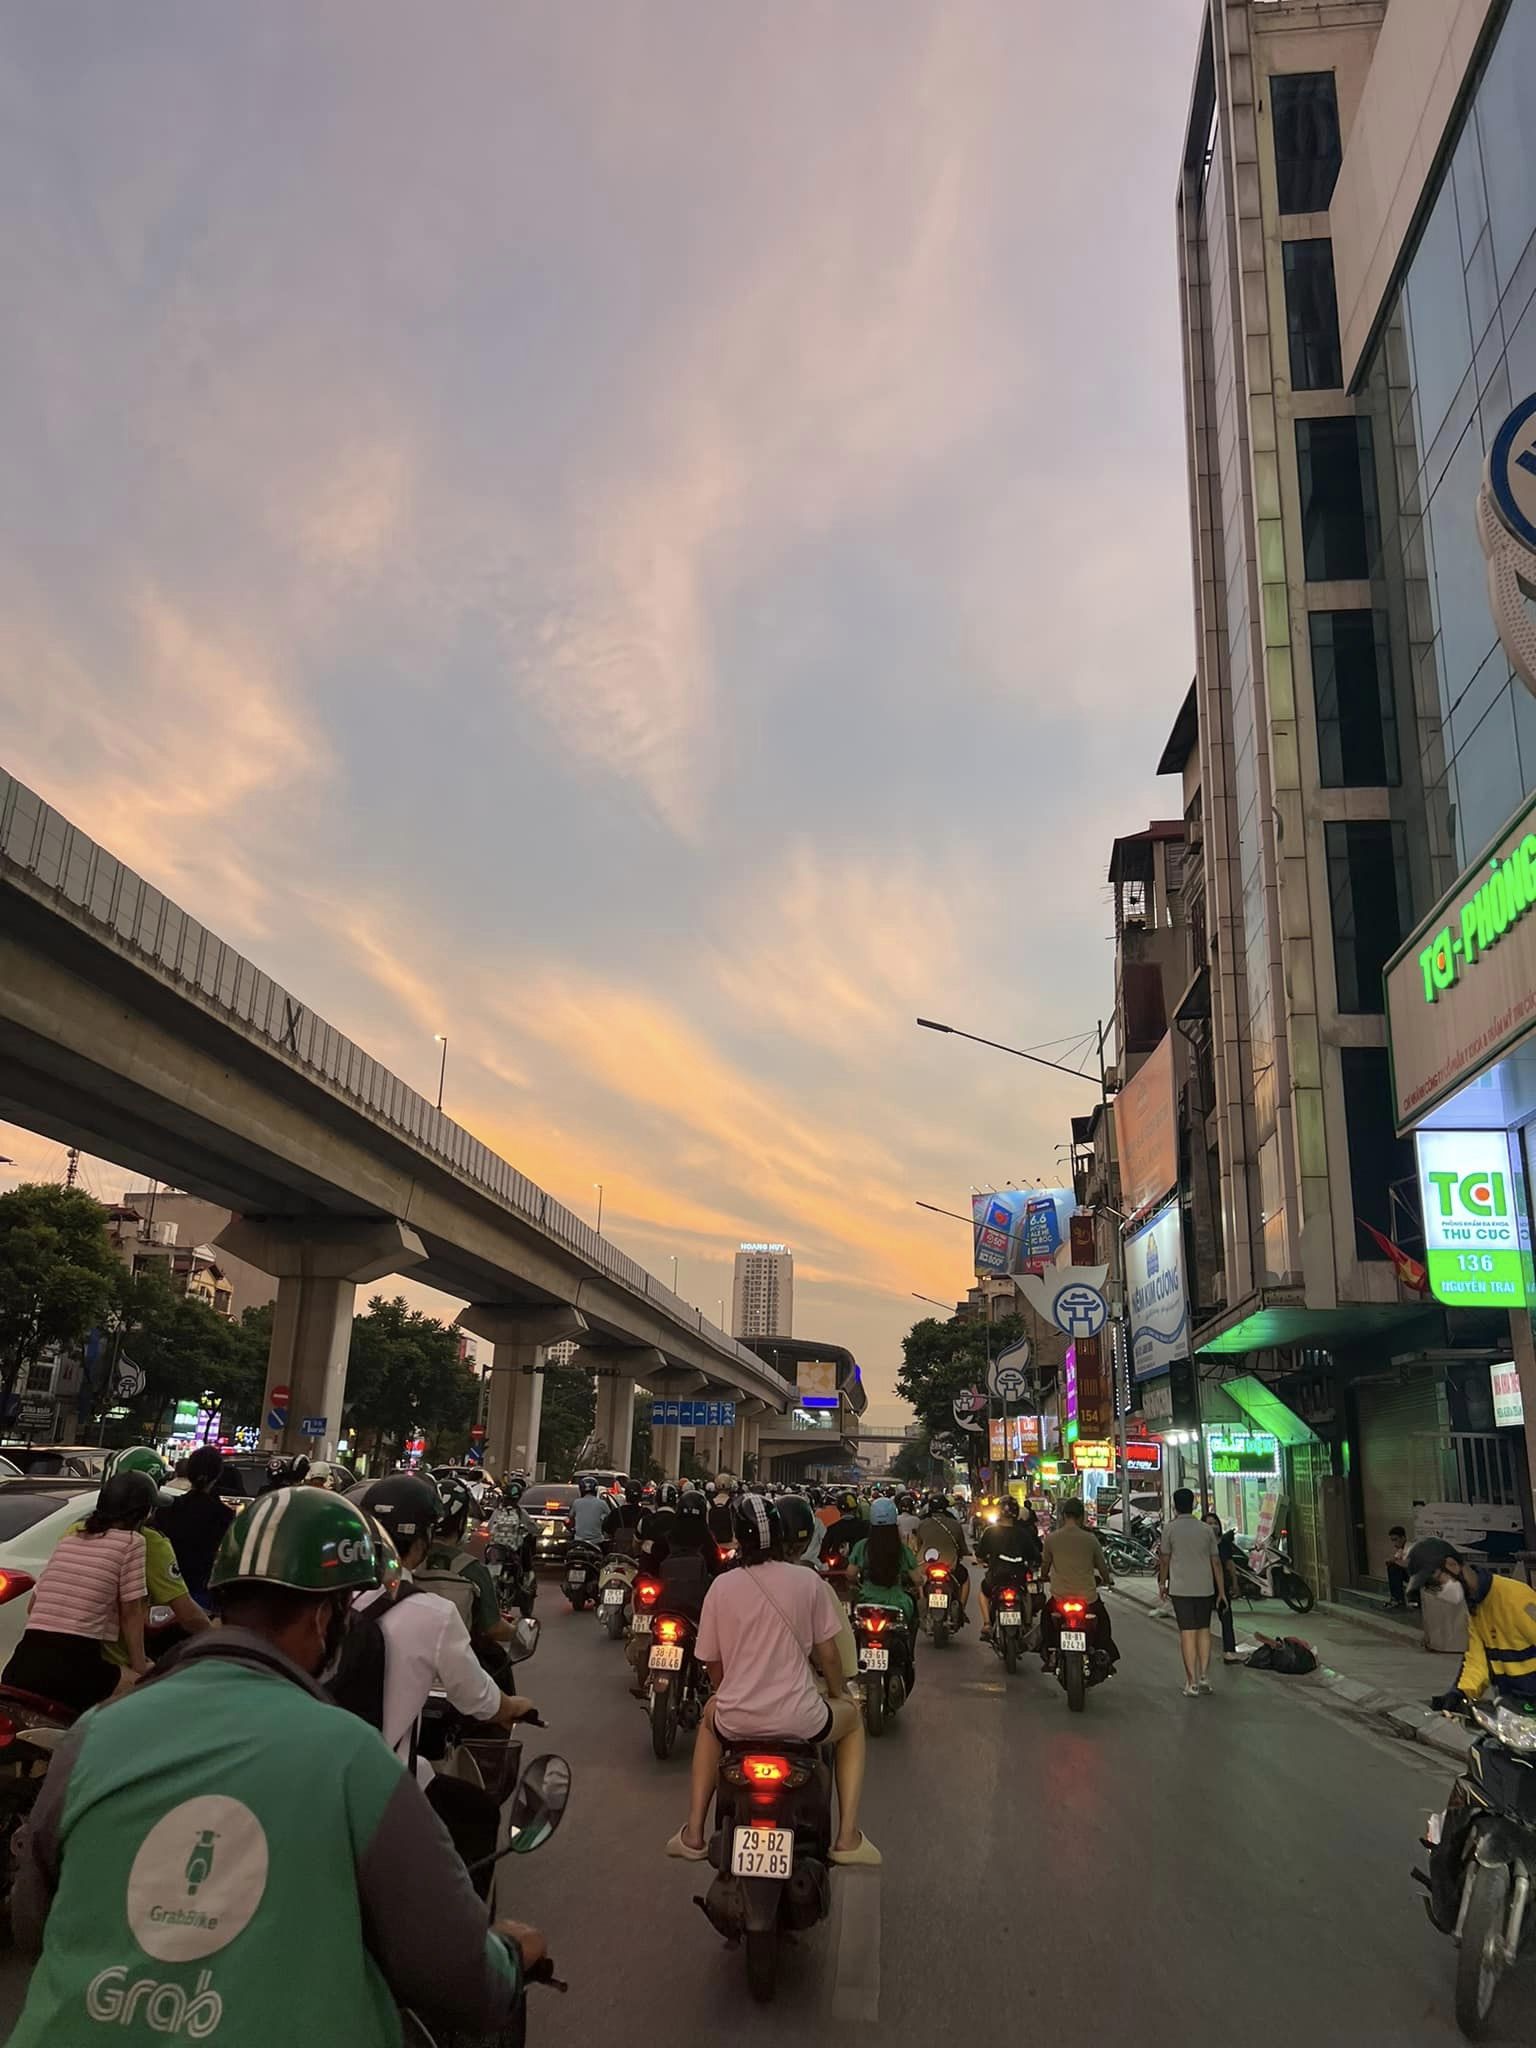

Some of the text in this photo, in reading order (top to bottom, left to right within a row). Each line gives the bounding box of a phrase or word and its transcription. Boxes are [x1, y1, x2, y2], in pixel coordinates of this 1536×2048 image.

[1428, 1171, 1508, 1217] TCI
[1442, 1228, 1471, 1240] THU
[1457, 1254, 1493, 1272] 136
[1080, 1408, 1099, 1423] 154
[742, 1830, 784, 1852] 29-B2
[737, 1851, 788, 1875] 137.85
[150, 1905, 219, 1931] GrabBike
[86, 1957, 223, 2039] Grab
